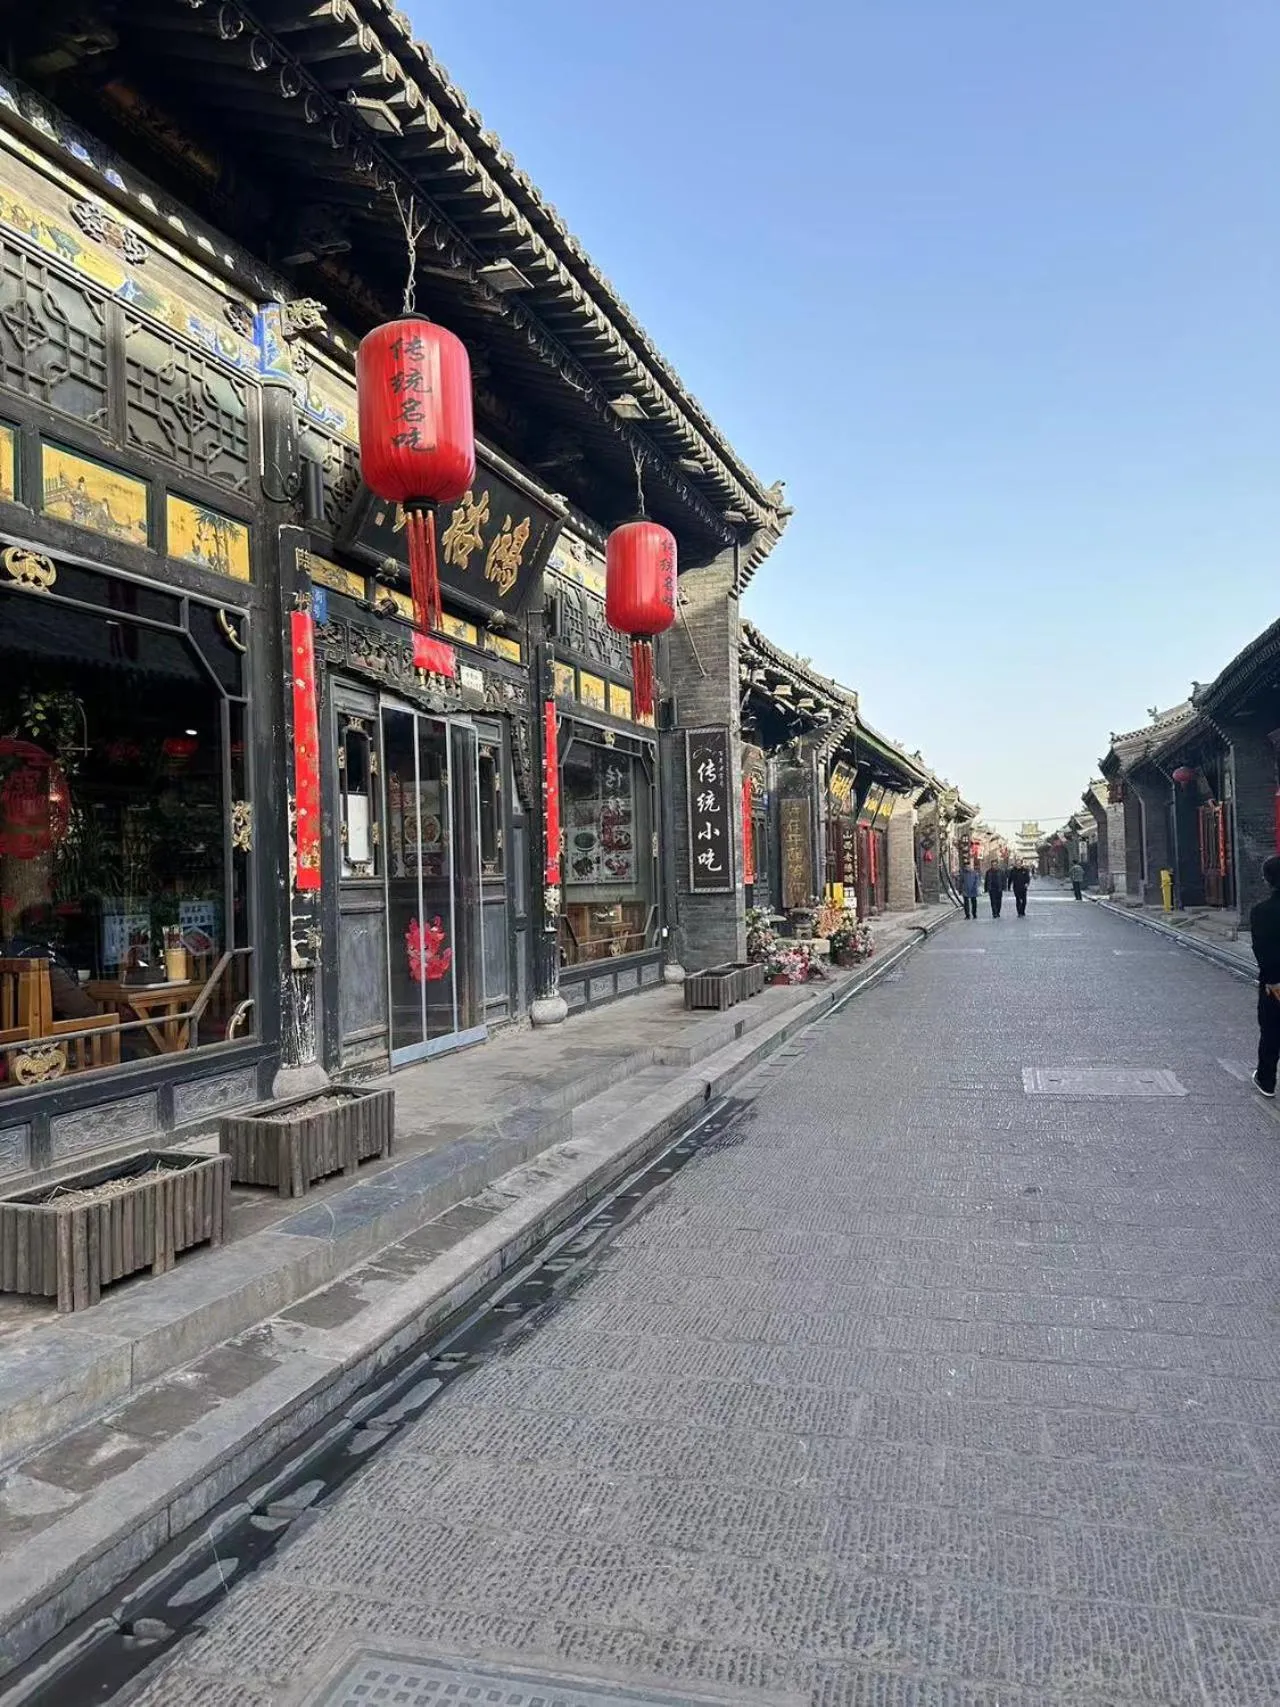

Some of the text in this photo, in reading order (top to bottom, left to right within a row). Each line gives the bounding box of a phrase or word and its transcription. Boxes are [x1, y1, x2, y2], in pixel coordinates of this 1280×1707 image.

[388, 335, 436, 454] 传统名吃
[696, 758, 722, 872] 传统小吃
